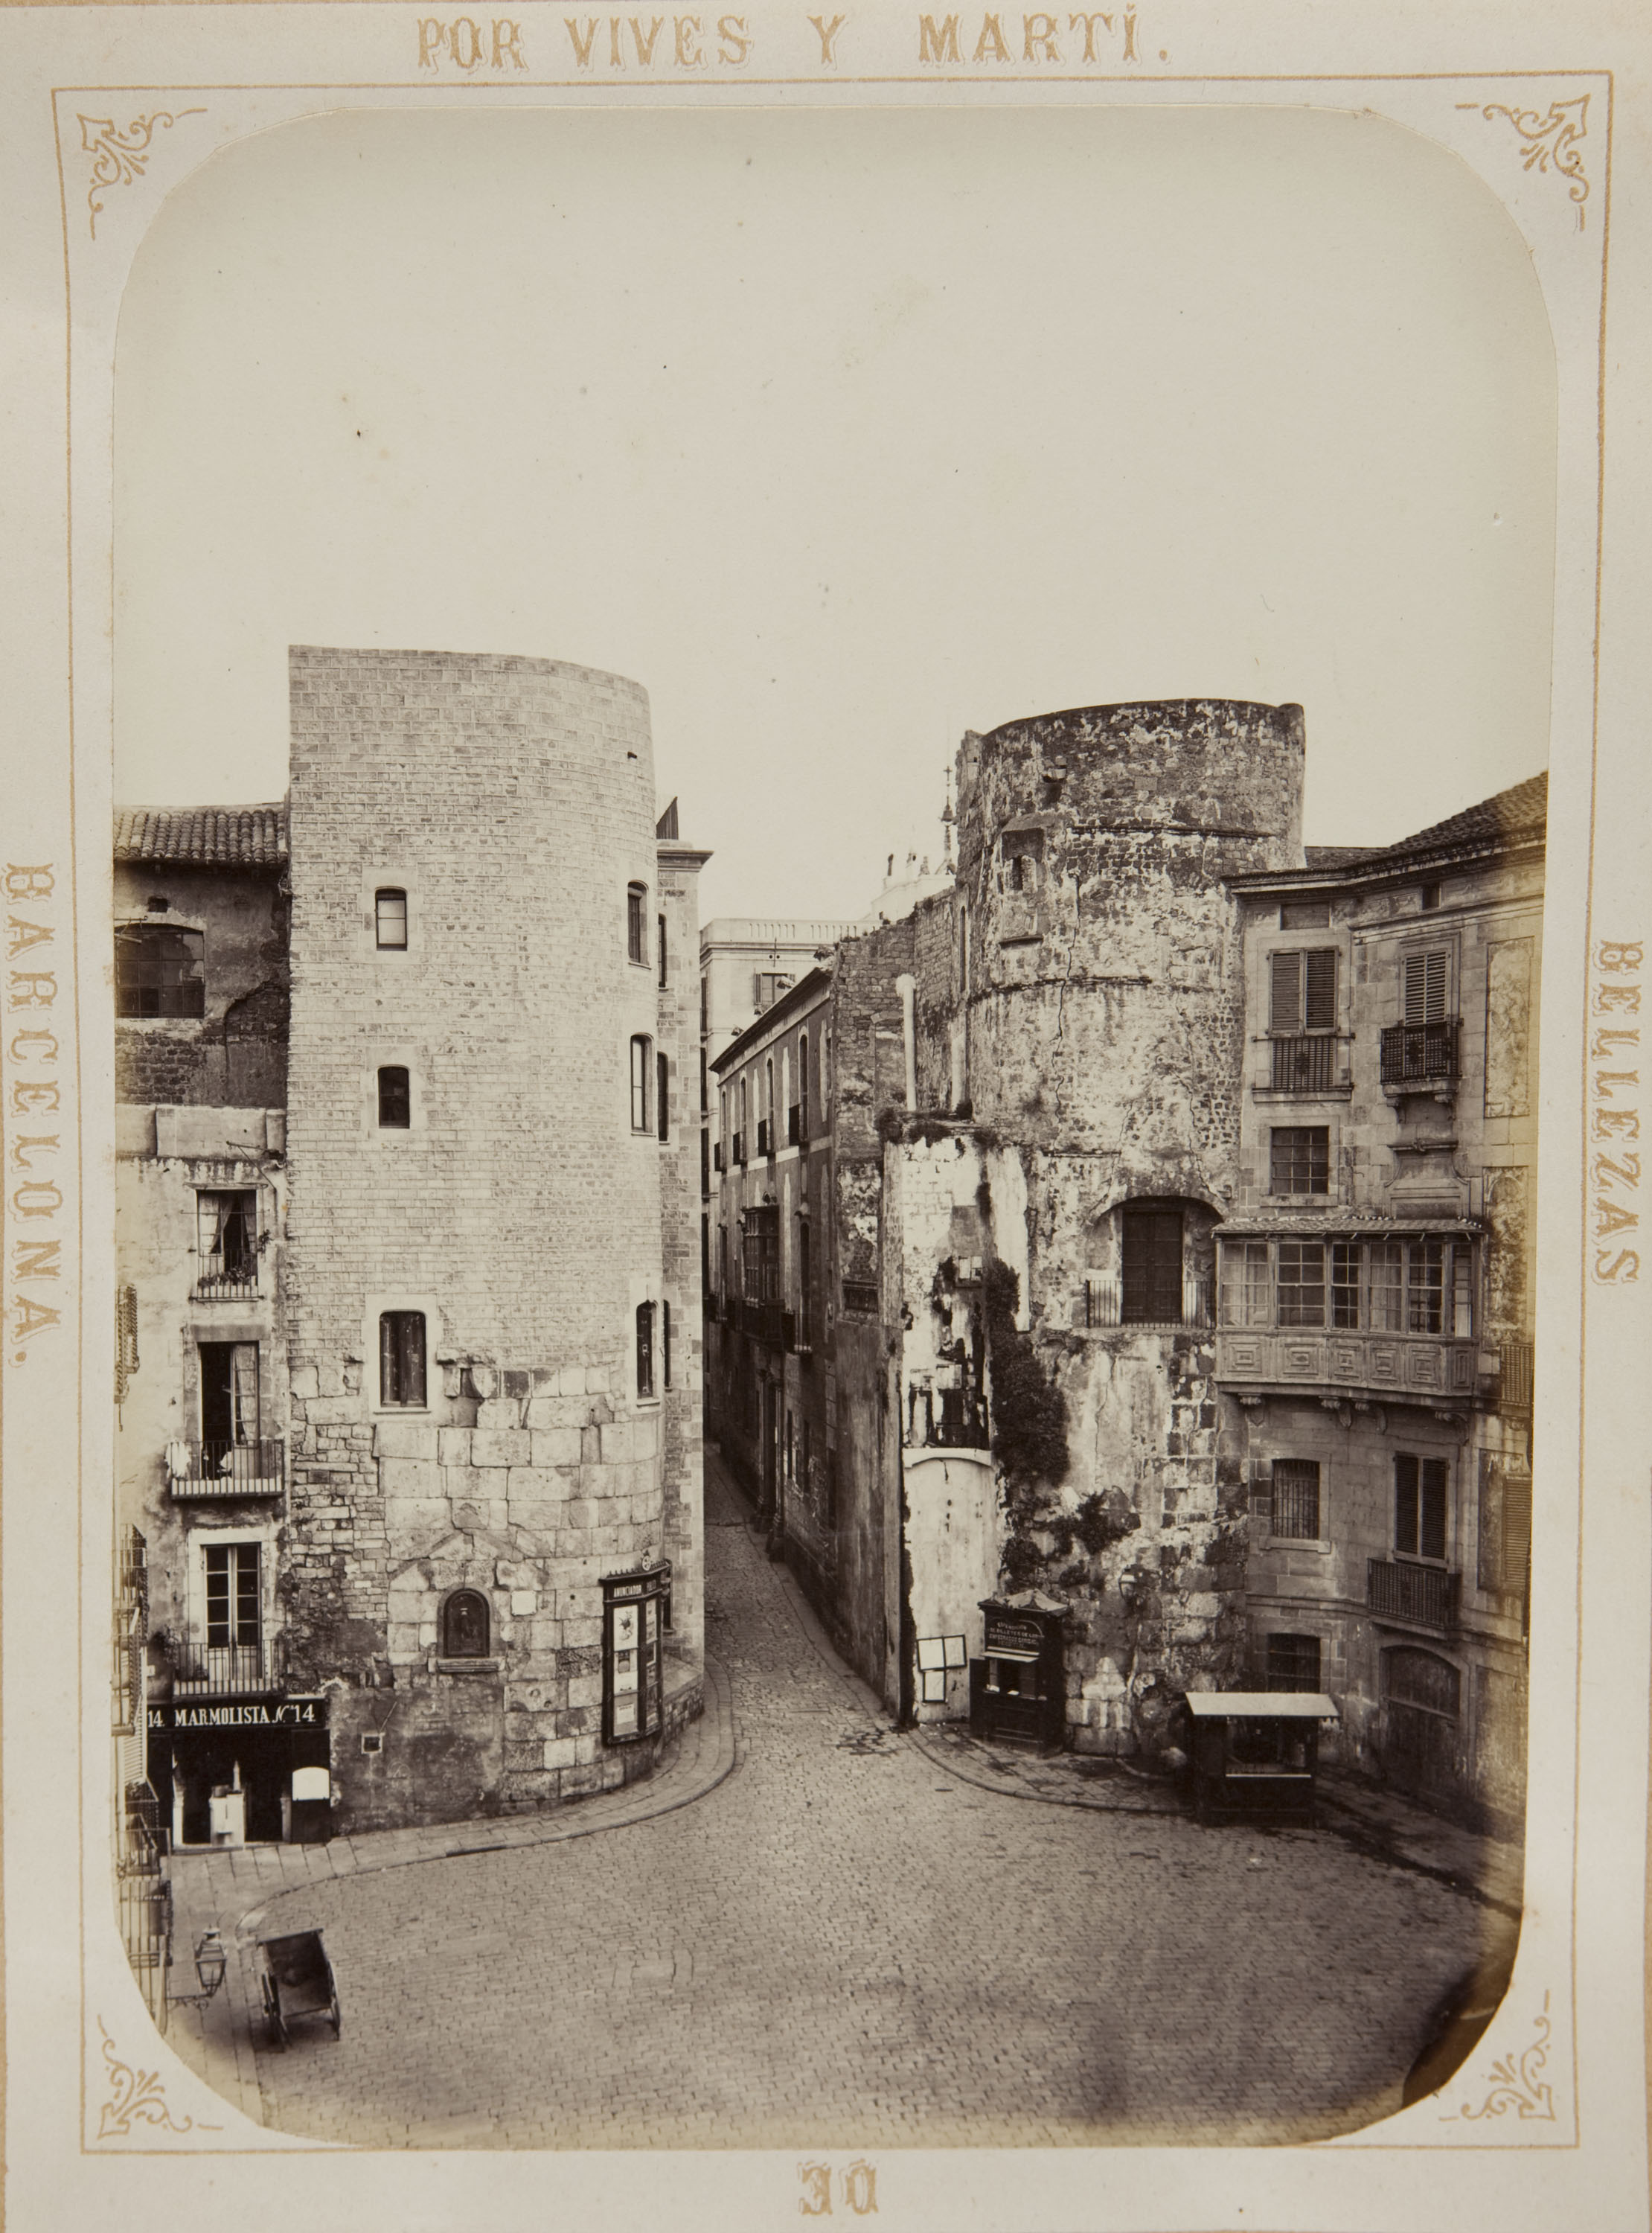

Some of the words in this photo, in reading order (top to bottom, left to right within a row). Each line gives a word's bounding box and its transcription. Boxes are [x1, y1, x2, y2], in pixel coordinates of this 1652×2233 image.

[417, 16, 527, 68] POR
[563, 15, 750, 67] VIVES
[807, 14, 849, 64] Y
[1591, 939, 1644, 1285] BELLEZAS
[613, 1585, 641, 1597] ANUNCIADOR
[174, 1705, 270, 1727] MARMOLISTA
